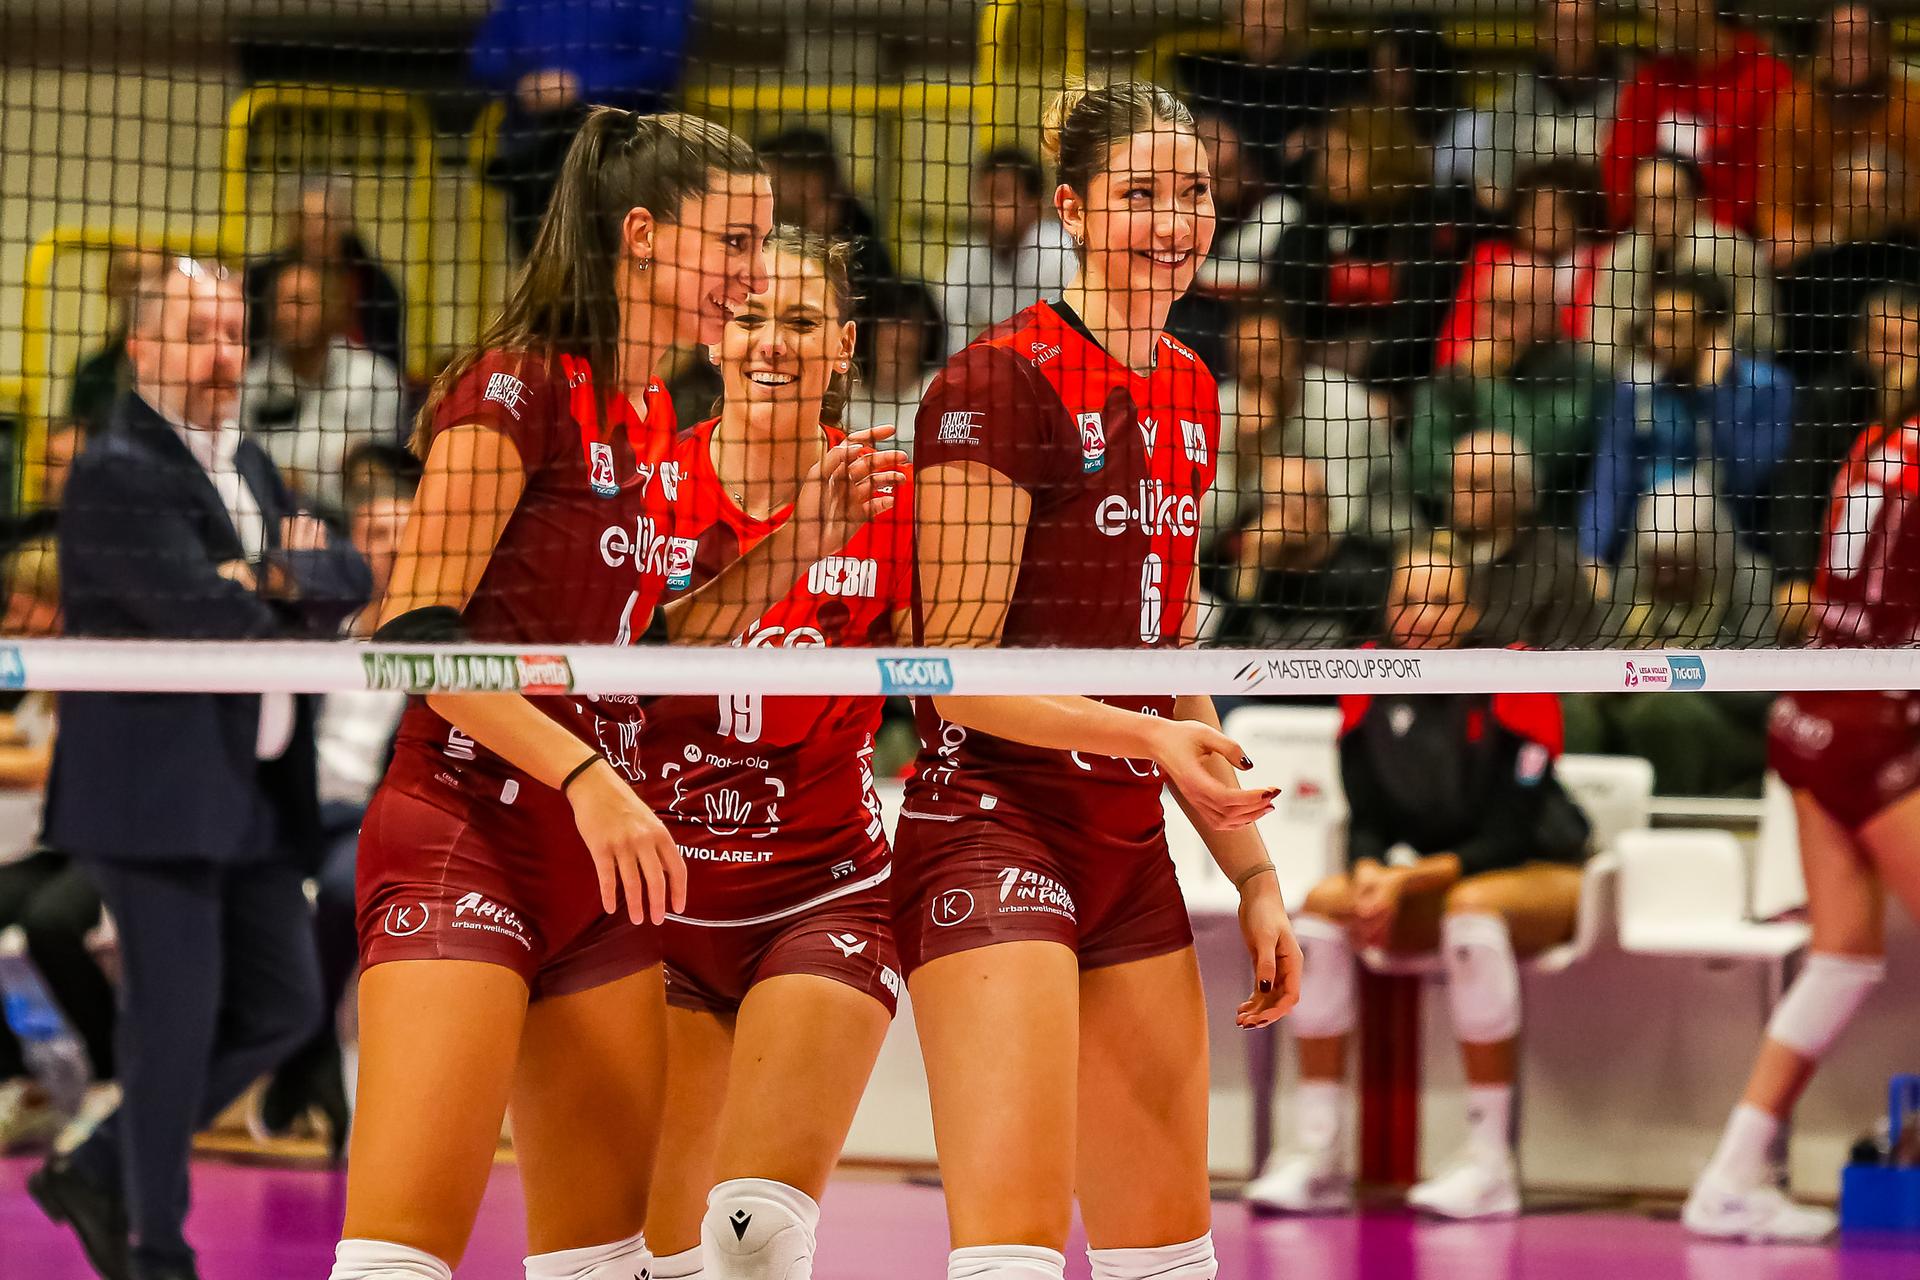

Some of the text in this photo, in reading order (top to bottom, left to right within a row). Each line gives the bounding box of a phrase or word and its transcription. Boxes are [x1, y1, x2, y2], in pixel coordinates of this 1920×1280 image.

[1140, 552, 1162, 644] 6
[1267, 659, 1325, 679] MASTER
[717, 694, 763, 743] 19
[676, 844, 773, 863] IVIOLARE.IT
[999, 905, 1029, 913] urban
[451, 920, 482, 930] urban
[483, 923, 515, 937] wellness
